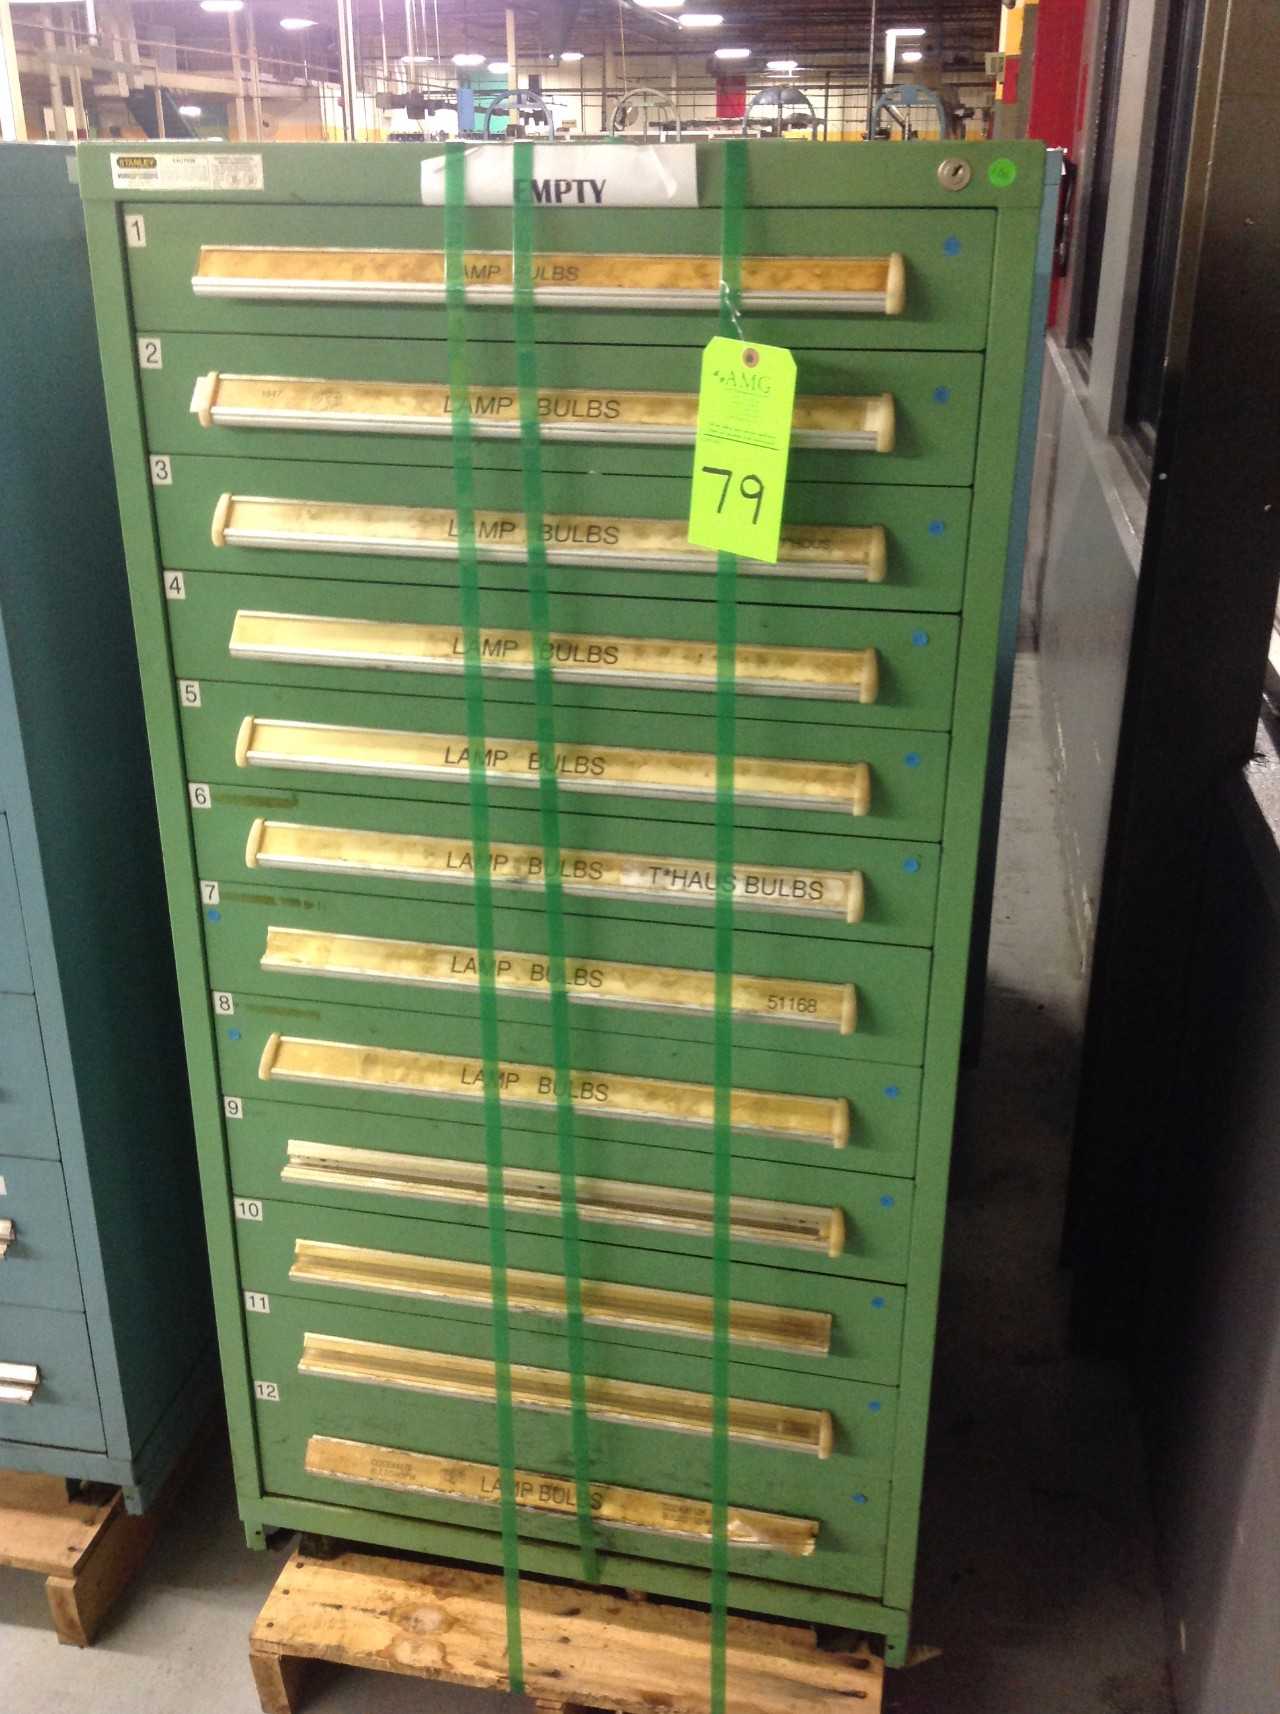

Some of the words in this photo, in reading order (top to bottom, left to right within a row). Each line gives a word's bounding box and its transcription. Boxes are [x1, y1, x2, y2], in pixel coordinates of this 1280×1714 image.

[513, 178, 607, 204] EMPTY
[131, 220, 141, 241] 1
[145, 342, 159, 364] 2
[444, 396, 513, 415] LAMP
[536, 399, 621, 419] BULBS
[155, 459, 169, 481] 3
[702, 466, 764, 525] 79
[538, 524, 620, 545] BULBS
[169, 575, 182, 595] 4
[539, 642, 619, 665] BULBS
[185, 684, 197, 703] 5
[444, 746, 509, 767] LAMP
[527, 753, 606, 776] BULBS
[195, 787, 207, 805] 6
[527, 856, 604, 880] BULBS
[744, 875, 824, 900] BULBS
[205, 884, 216, 901] 7
[219, 994, 231, 1012] 8
[767, 994, 818, 1014] 51168
[228, 1100, 239, 1115] 9
[239, 1202, 259, 1218] 10
[250, 1295, 266, 1310] 11
[258, 1384, 277, 1398] 12
[538, 1483, 604, 1511] BULS
